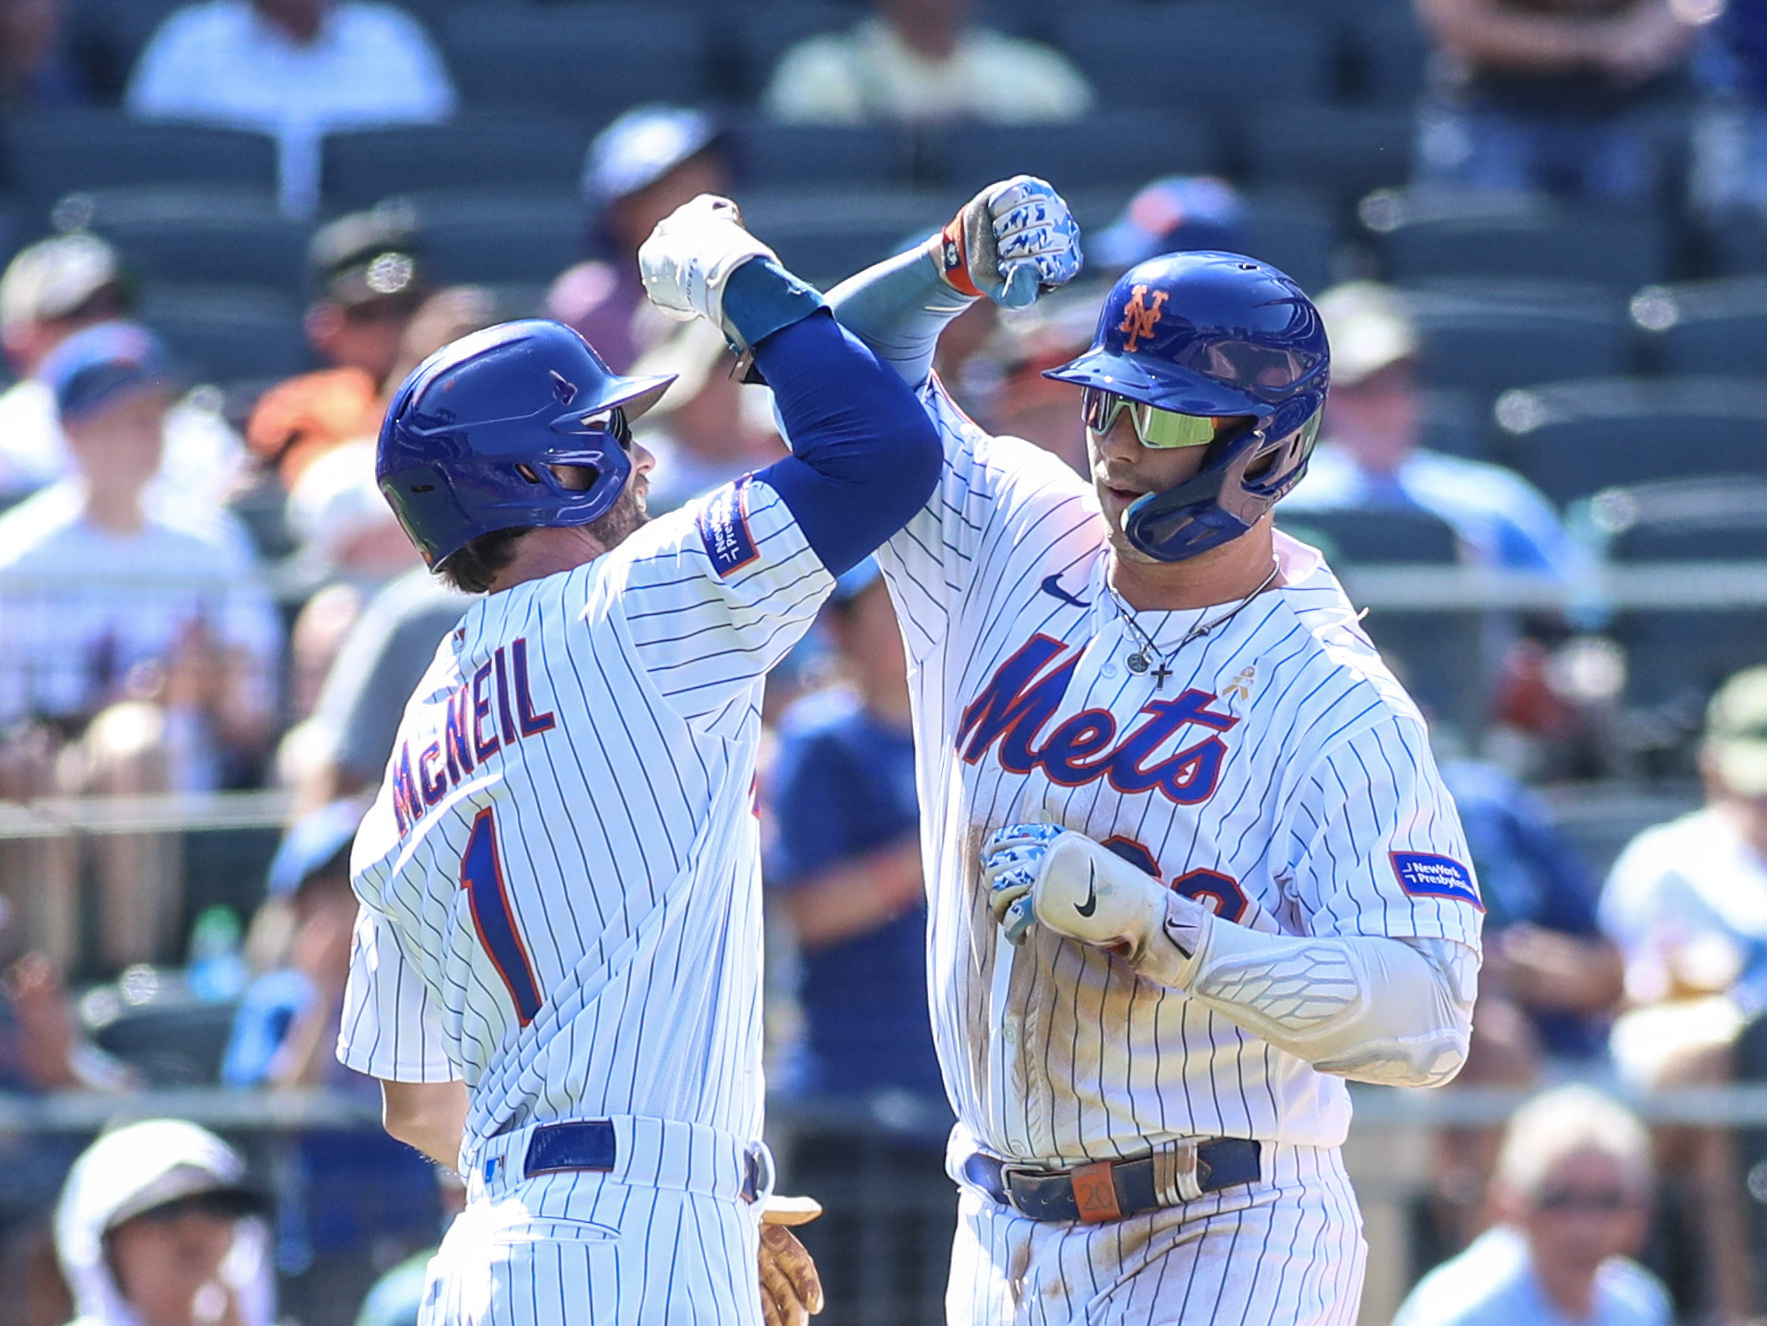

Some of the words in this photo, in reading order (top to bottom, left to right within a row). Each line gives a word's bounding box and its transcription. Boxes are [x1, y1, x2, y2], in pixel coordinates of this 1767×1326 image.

[955, 633, 1240, 806] Mets
[460, 805, 543, 1028] 1
[1079, 1182, 1113, 1211] 20
